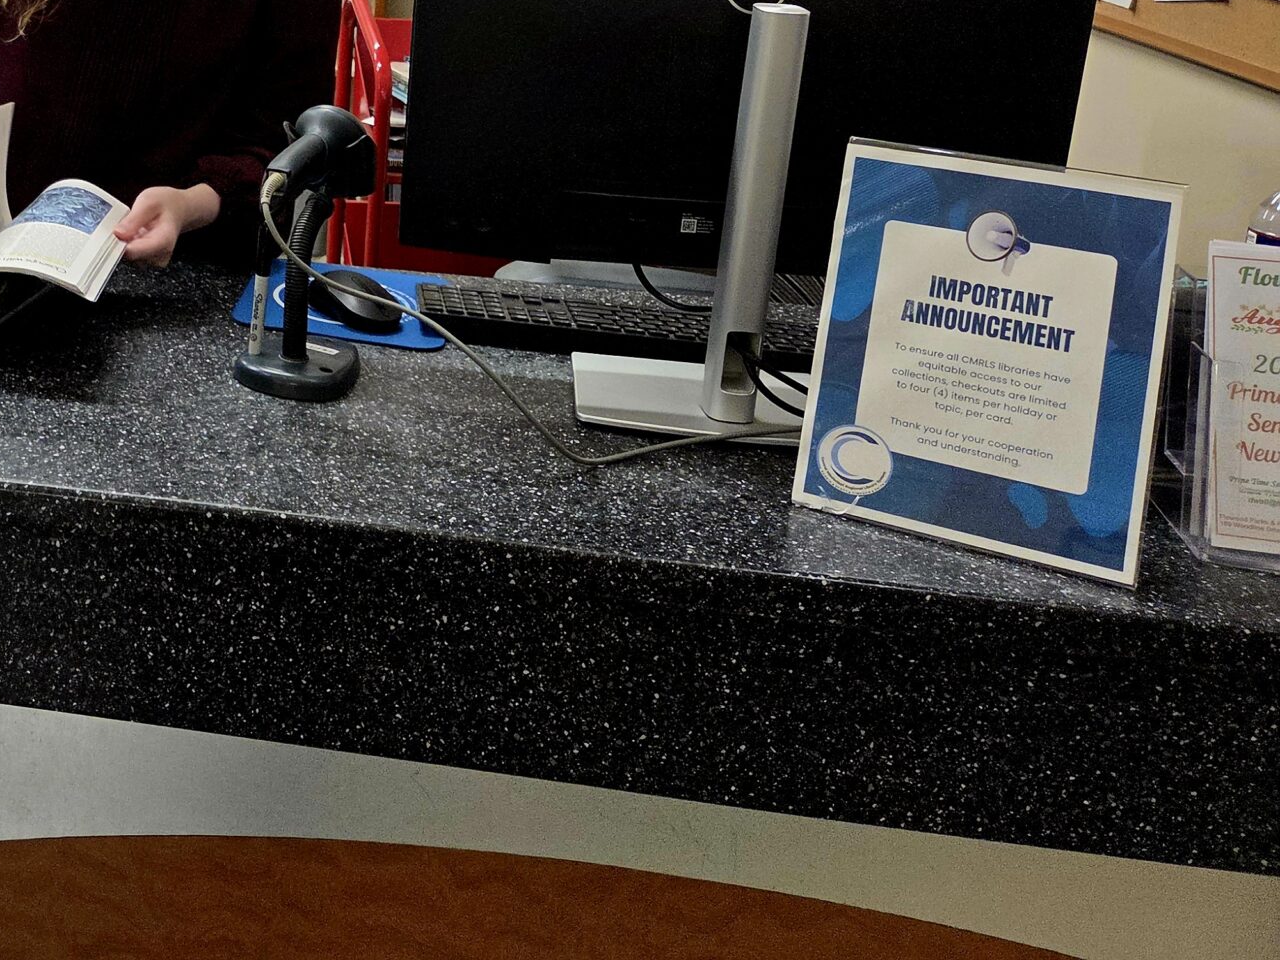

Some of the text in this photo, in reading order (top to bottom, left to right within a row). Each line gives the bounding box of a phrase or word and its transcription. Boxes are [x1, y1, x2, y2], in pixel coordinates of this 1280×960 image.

[928, 274, 1054, 318] IMPORTANT
[900, 299, 1076, 352] ANNOUNCEMENT
[895, 342, 1072, 385] To ensure all CMRLS libraries have
[918, 360, 1042, 392] equitable access to our
[892, 367, 1067, 410] collections, checkouts are limited
[896, 380, 1058, 422] to four (4) items per holiday or
[934, 402, 1014, 426] topic, per card.
[890, 416, 1054, 460] Thank you for your cooperation
[917, 436, 1021, 468] and understanding.
